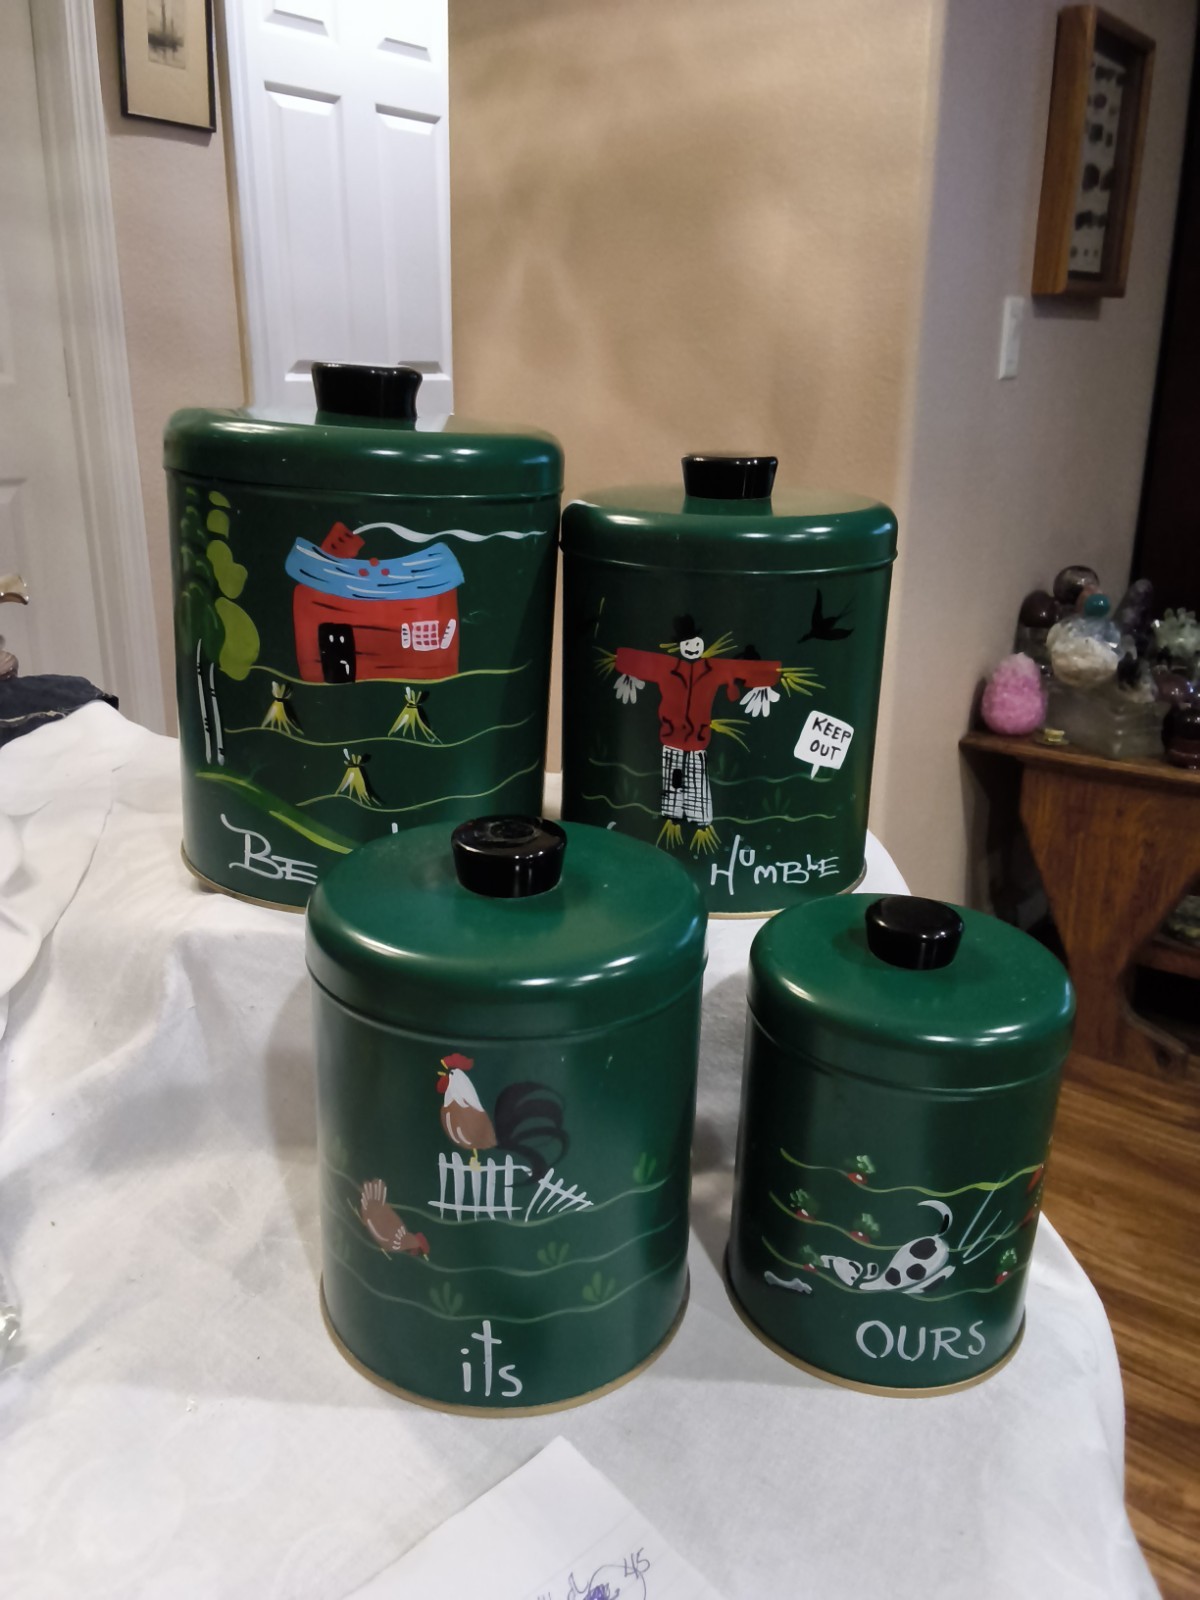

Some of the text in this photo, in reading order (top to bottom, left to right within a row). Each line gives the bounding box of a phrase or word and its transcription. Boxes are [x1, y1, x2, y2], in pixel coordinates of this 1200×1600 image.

[809, 739, 842, 761] OUT
[812, 716, 852, 743] KEEP
[710, 834, 840, 896] HUMBLE
[460, 1319, 523, 1397] its
[855, 1319, 986, 1362] OURS
